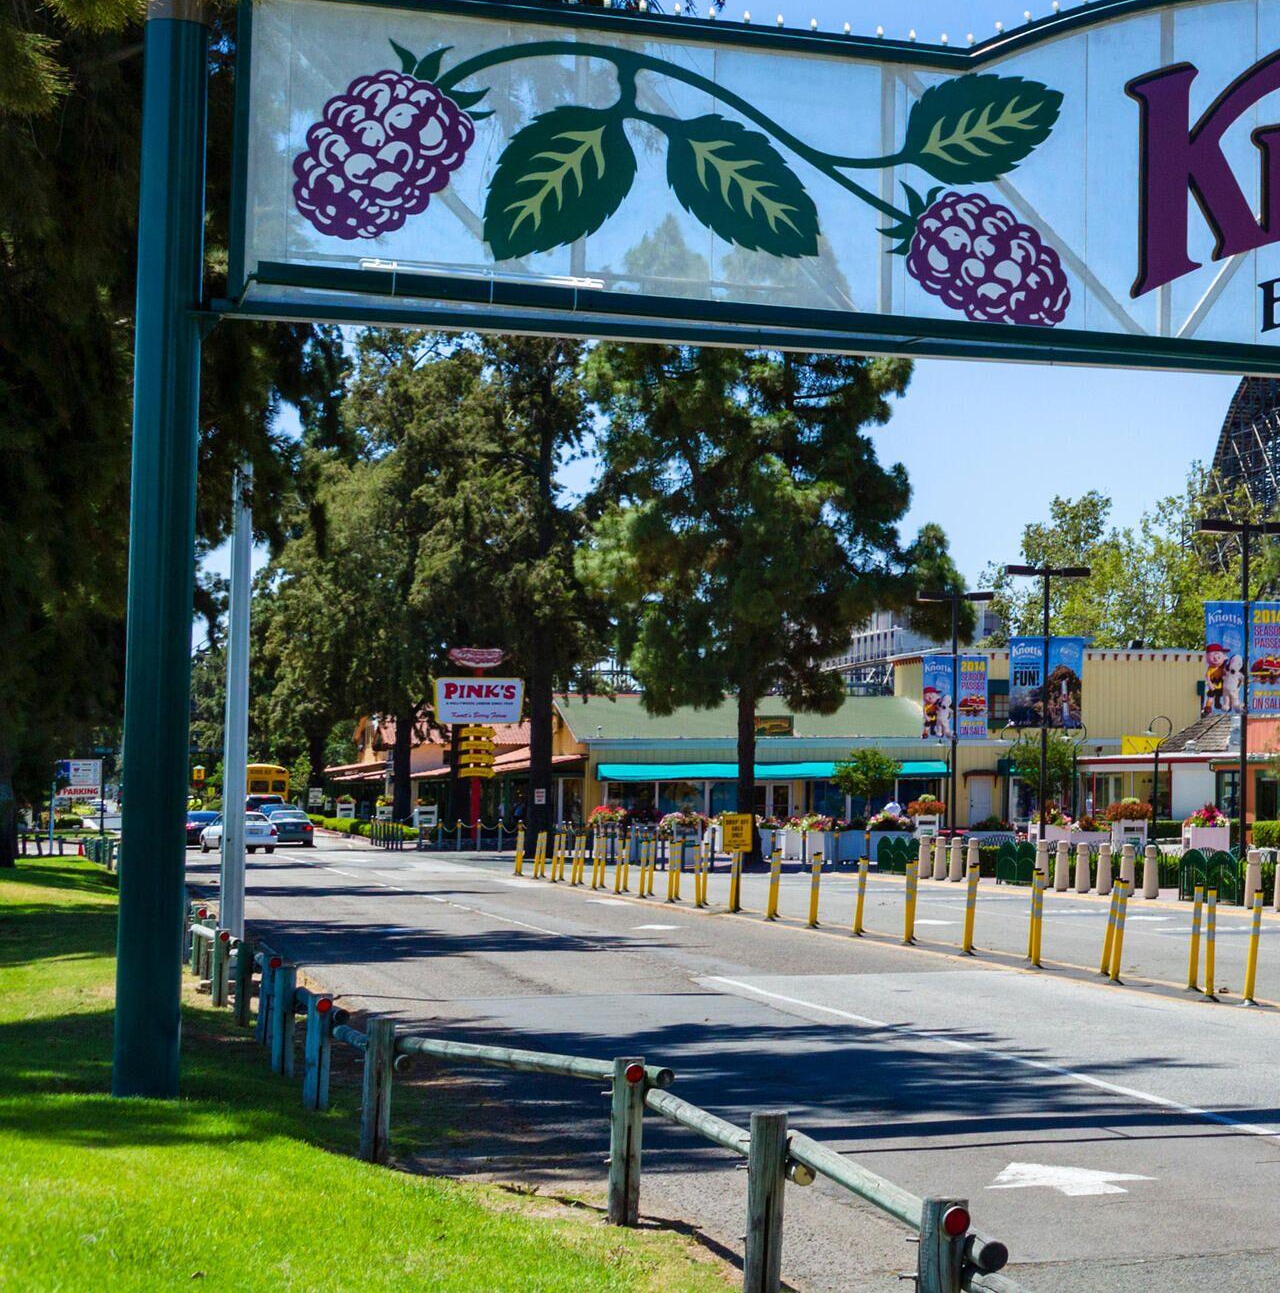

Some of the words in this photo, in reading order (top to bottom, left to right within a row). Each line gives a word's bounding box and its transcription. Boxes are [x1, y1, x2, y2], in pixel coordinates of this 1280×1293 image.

[961, 661, 986, 673] 2014
[1013, 669, 1040, 687] FUN!
[444, 682, 516, 700] PINK'S
